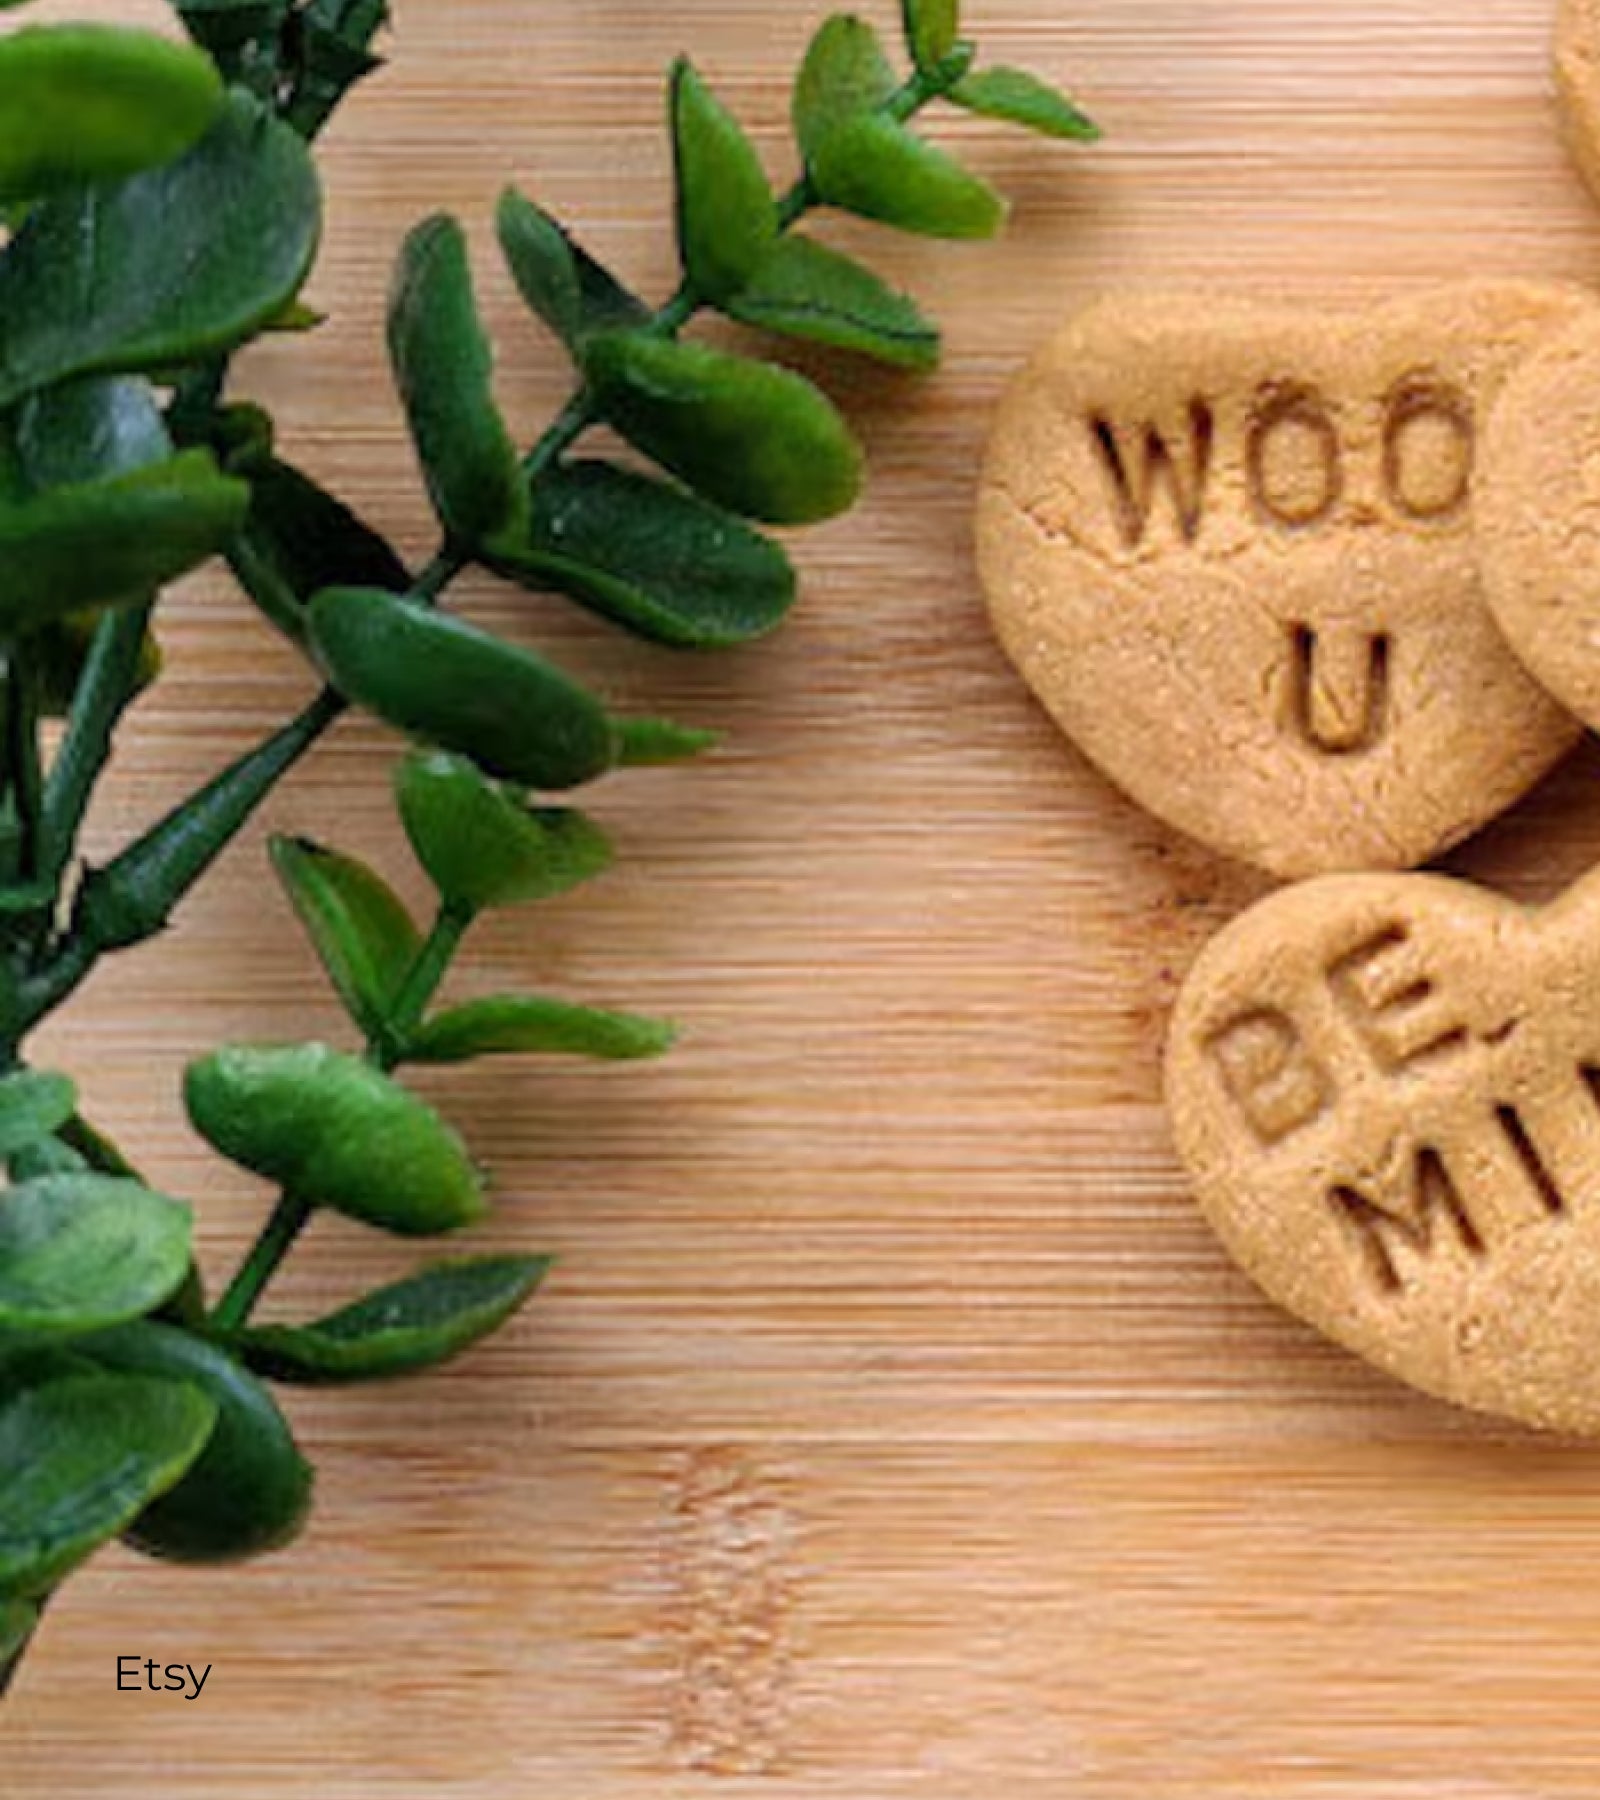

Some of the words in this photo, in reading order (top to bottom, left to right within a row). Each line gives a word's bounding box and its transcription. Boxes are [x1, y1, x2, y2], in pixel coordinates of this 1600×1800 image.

[1088, 364, 1474, 548] WOO
[1284, 616, 1392, 756] U
[1198, 920, 1472, 1148] BE
